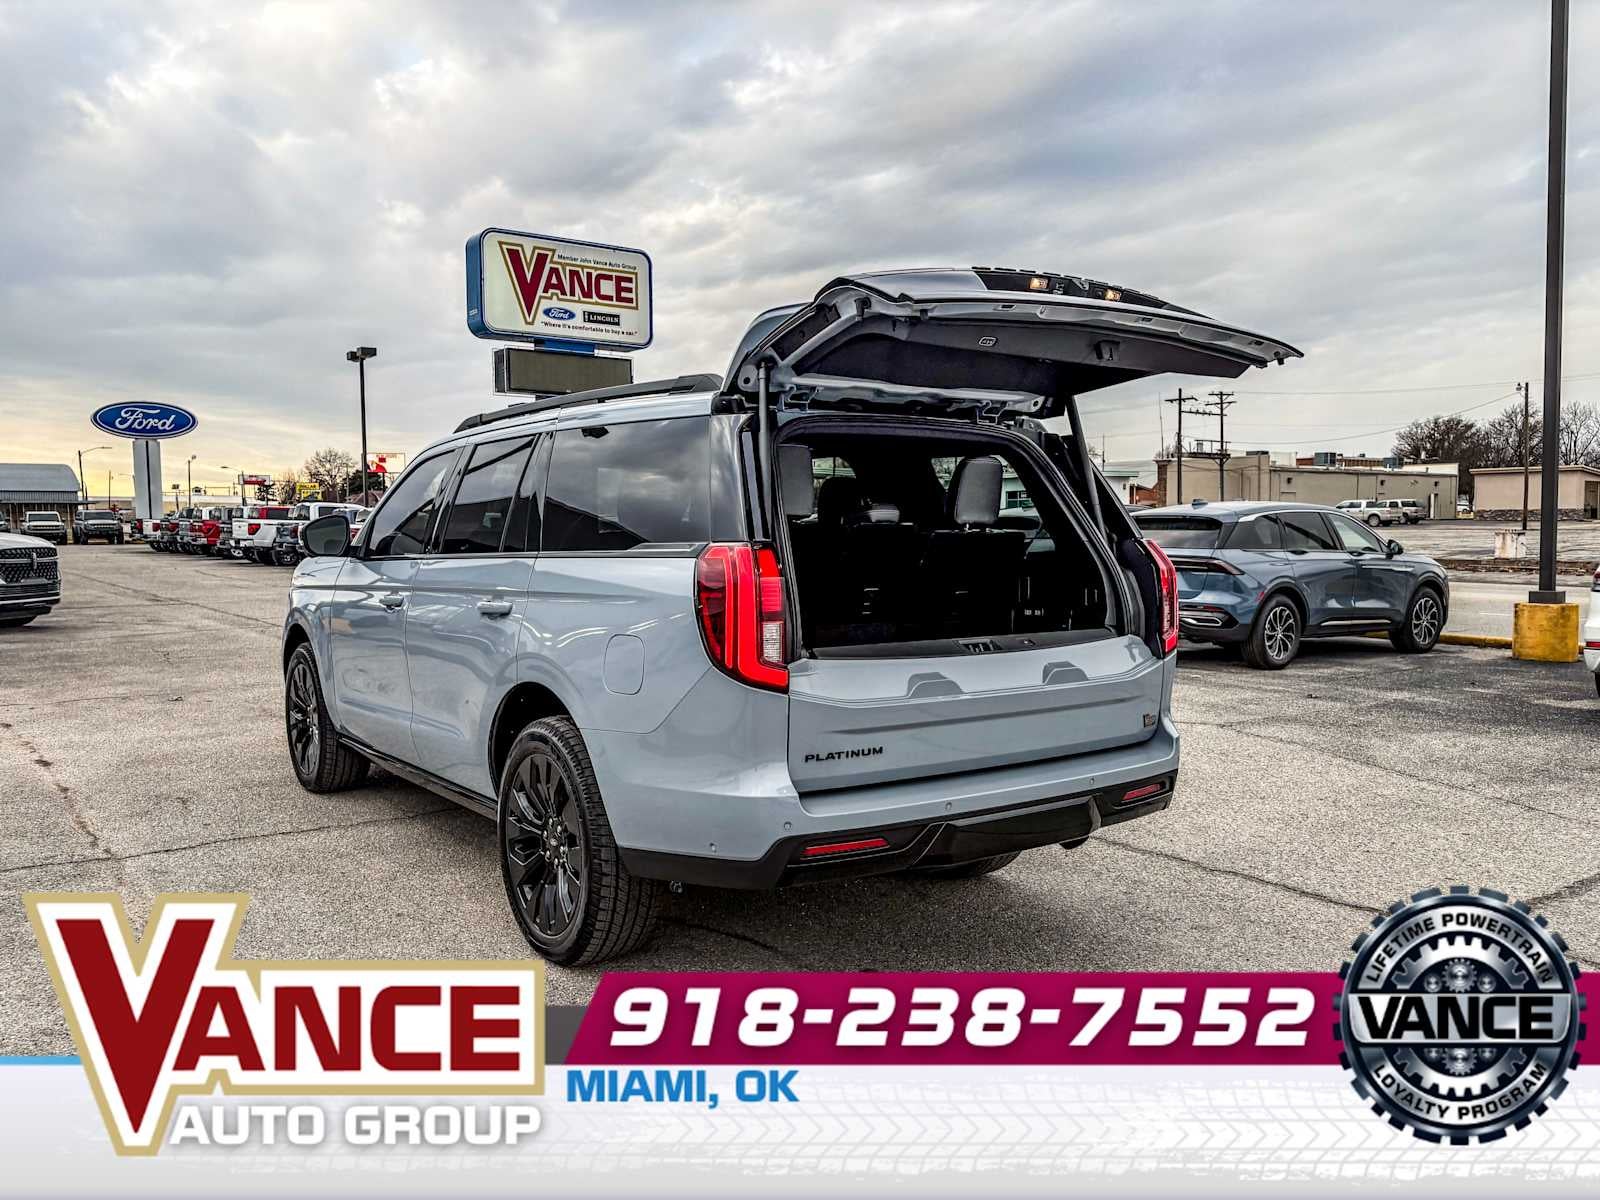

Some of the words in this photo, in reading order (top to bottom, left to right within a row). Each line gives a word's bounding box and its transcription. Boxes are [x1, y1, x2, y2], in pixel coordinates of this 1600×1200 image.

[593, 258, 607, 266] Vance
[608, 260, 620, 268] Auto
[621, 262, 637, 270] Group
[505, 248, 634, 319] VANCE
[549, 309, 569, 319] Ford
[589, 314, 619, 323] LINCOLN
[571, 325, 603, 333] comfortable
[611, 328, 621, 336] buy
[115, 407, 176, 430] Ford
[804, 746, 884, 764] PLATINUM
